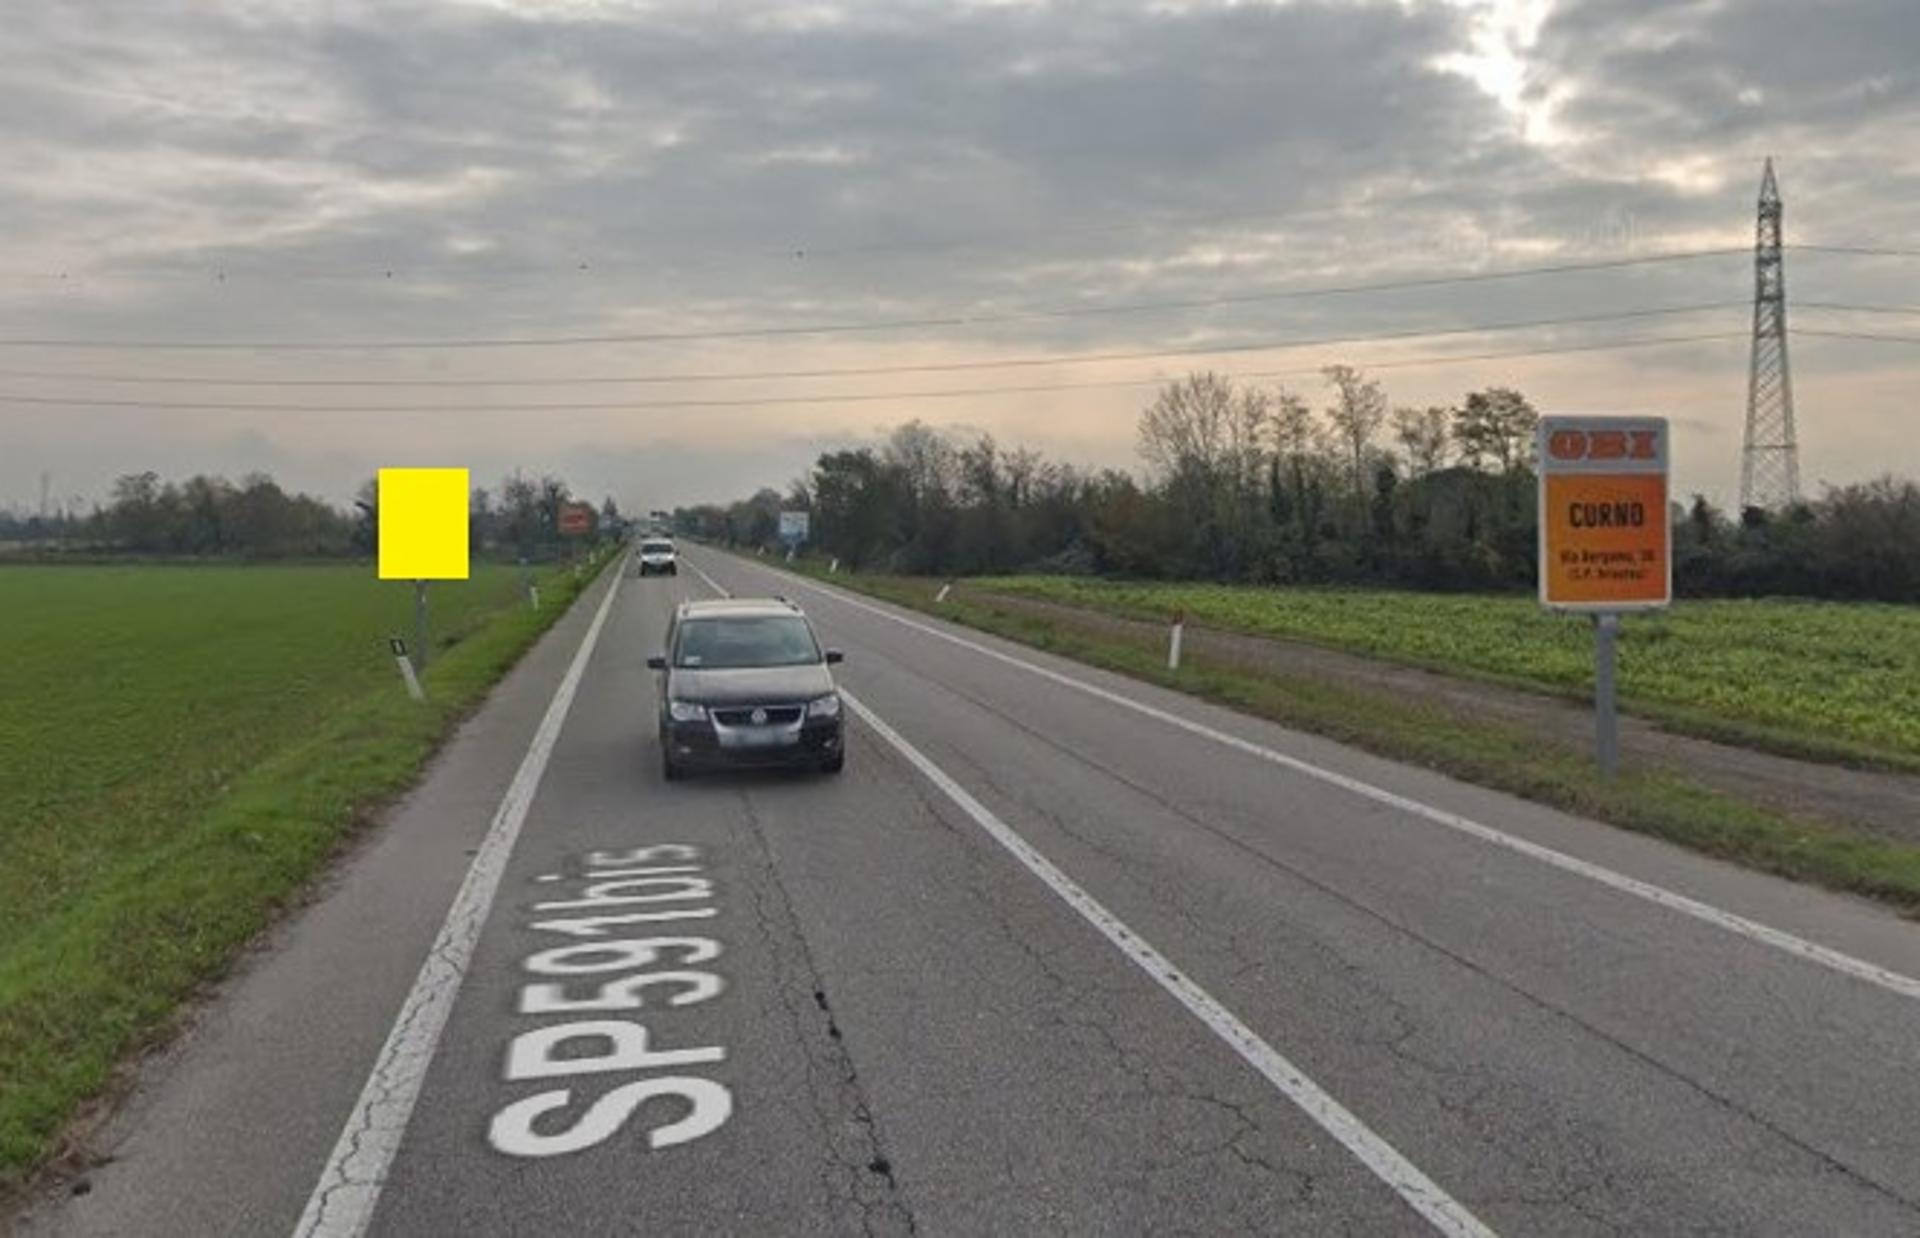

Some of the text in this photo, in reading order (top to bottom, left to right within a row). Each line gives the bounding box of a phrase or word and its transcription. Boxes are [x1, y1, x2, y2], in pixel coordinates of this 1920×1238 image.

[1550, 430, 1656, 460] OBI
[1569, 502, 1644, 528] CURNO
[488, 844, 732, 1156] SP591bis
